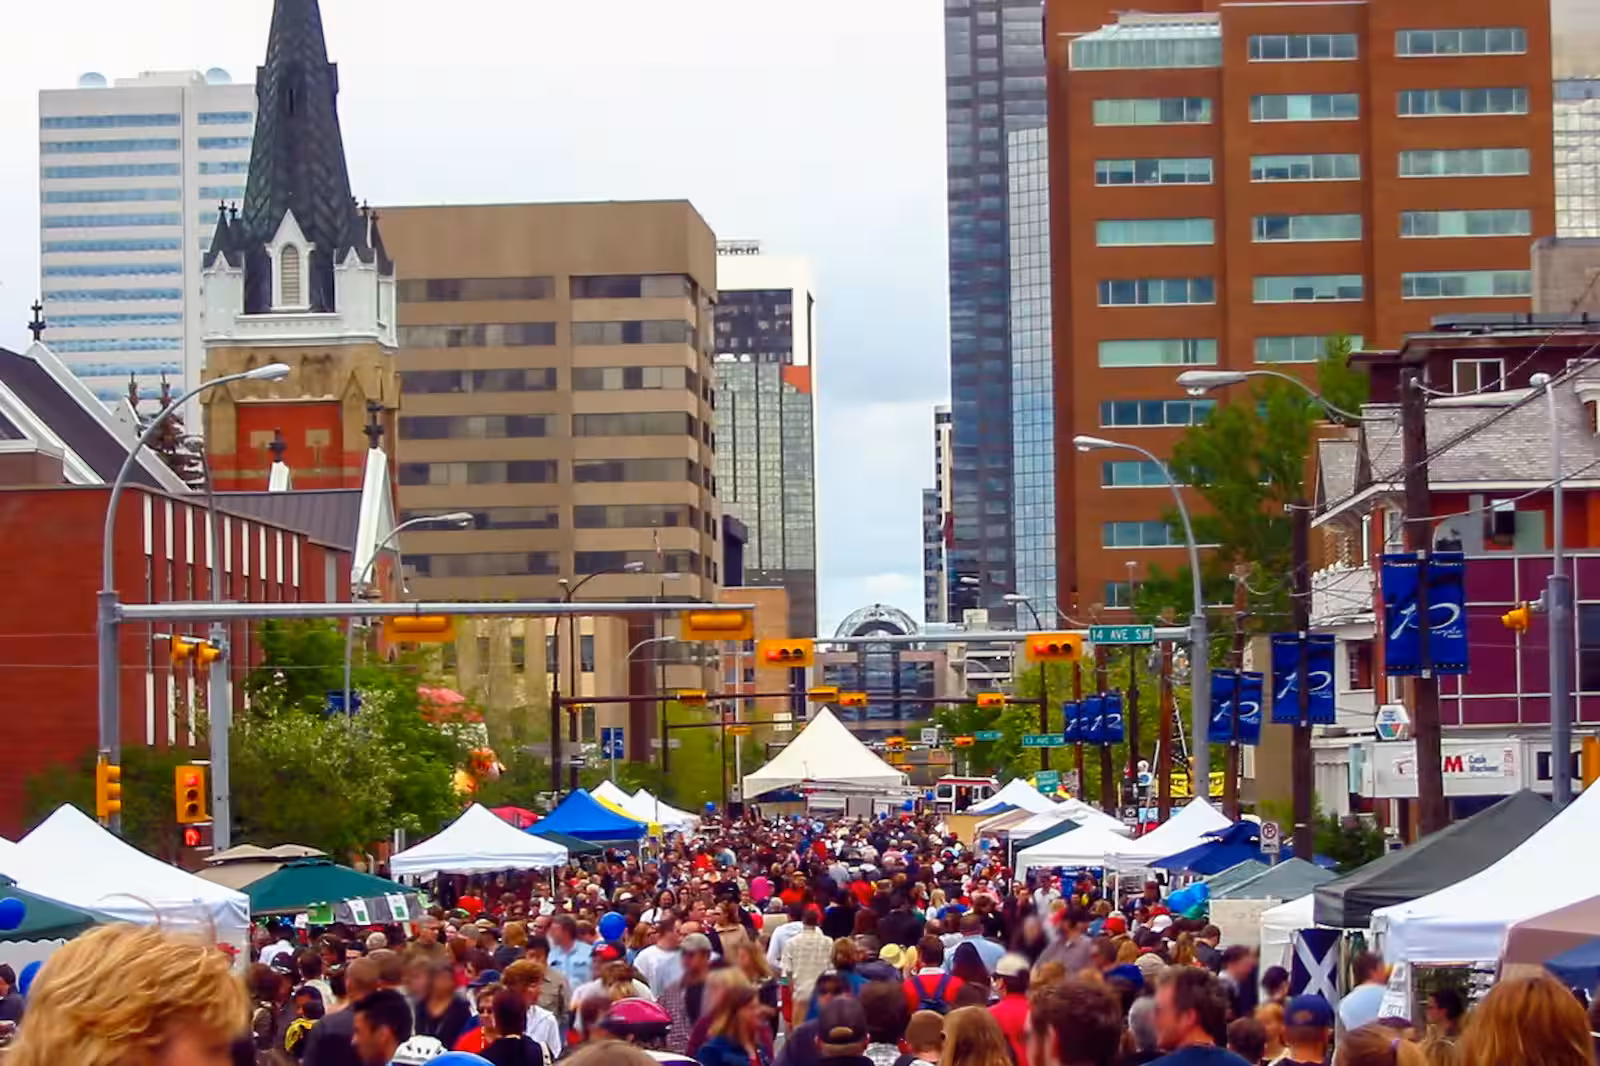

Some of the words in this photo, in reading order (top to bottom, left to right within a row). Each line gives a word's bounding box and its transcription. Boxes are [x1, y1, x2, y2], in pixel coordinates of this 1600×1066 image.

[1092, 629, 1104, 640] 14
[1110, 629, 1129, 640] AVE
[1135, 628, 1151, 640] SW
